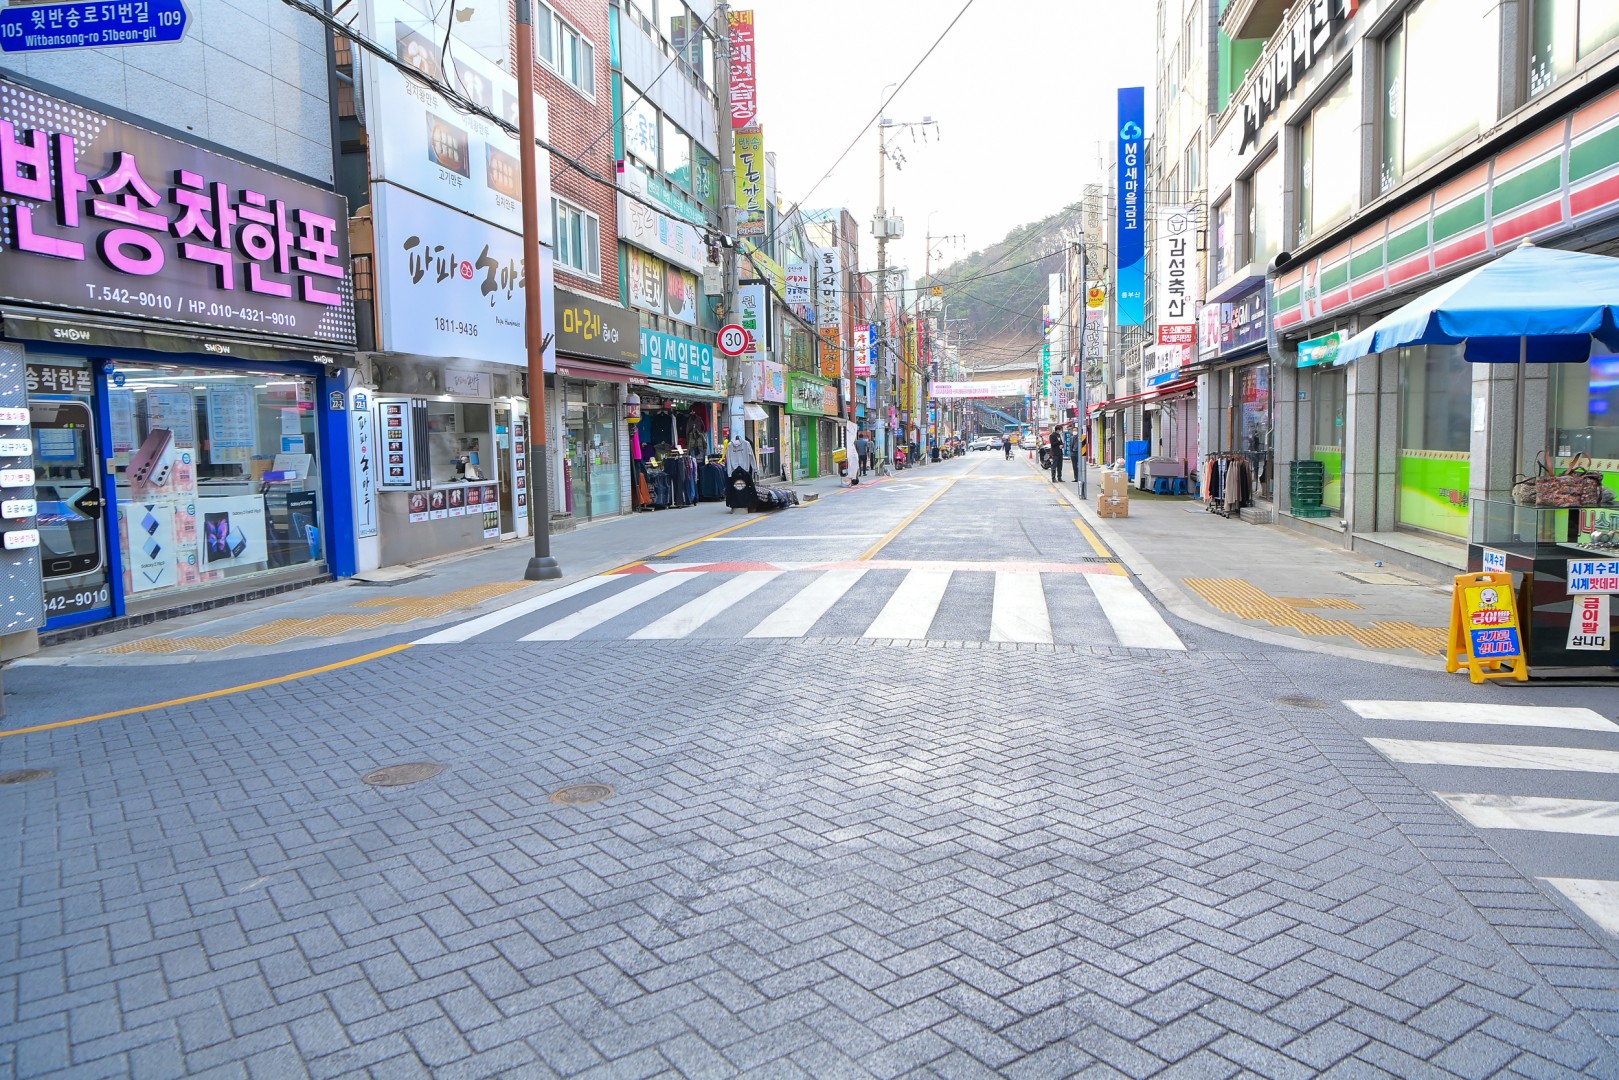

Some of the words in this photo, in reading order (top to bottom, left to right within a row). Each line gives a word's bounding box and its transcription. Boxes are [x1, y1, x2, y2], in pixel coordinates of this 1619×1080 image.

[158, 11, 181, 26] 109
[1, 23, 23, 37] 105
[25, 33, 99, 46] Witbansong-ro
[102, 26, 157, 41] 51beon-gil
[738, 135, 760, 150] 반송
[438, 169, 463, 189] 고기만두
[1124, 142, 1138, 230] MG새마을금고
[495, 194, 516, 213] 김치만두
[0, 121, 345, 306] 반송착한폰
[822, 252, 837, 297] 동그라미
[1168, 238, 1186, 318] 감성축산
[86, 283, 172, 311] T.542-9010
[189, 299, 296, 327] HP.010-4321-9010
[435, 316, 478, 336] 1811-9436
[563, 308, 601, 341] 마레
[54, 328, 90, 341] SHOW
[725, 333, 742, 347] 30
[205, 343, 231, 354] SHOW
[313, 355, 334, 364] SHOW
[333, 400, 343, 408] 22-2
[356, 401, 366, 409] 22-1
[1484, 552, 1504, 567] 시계수리
[1571, 562, 1619, 576] 시계수리
[1472, 610, 1511, 624] 금이빨
[1582, 597, 1600, 634] 금이빨
[1477, 630, 1510, 643] 고가로
